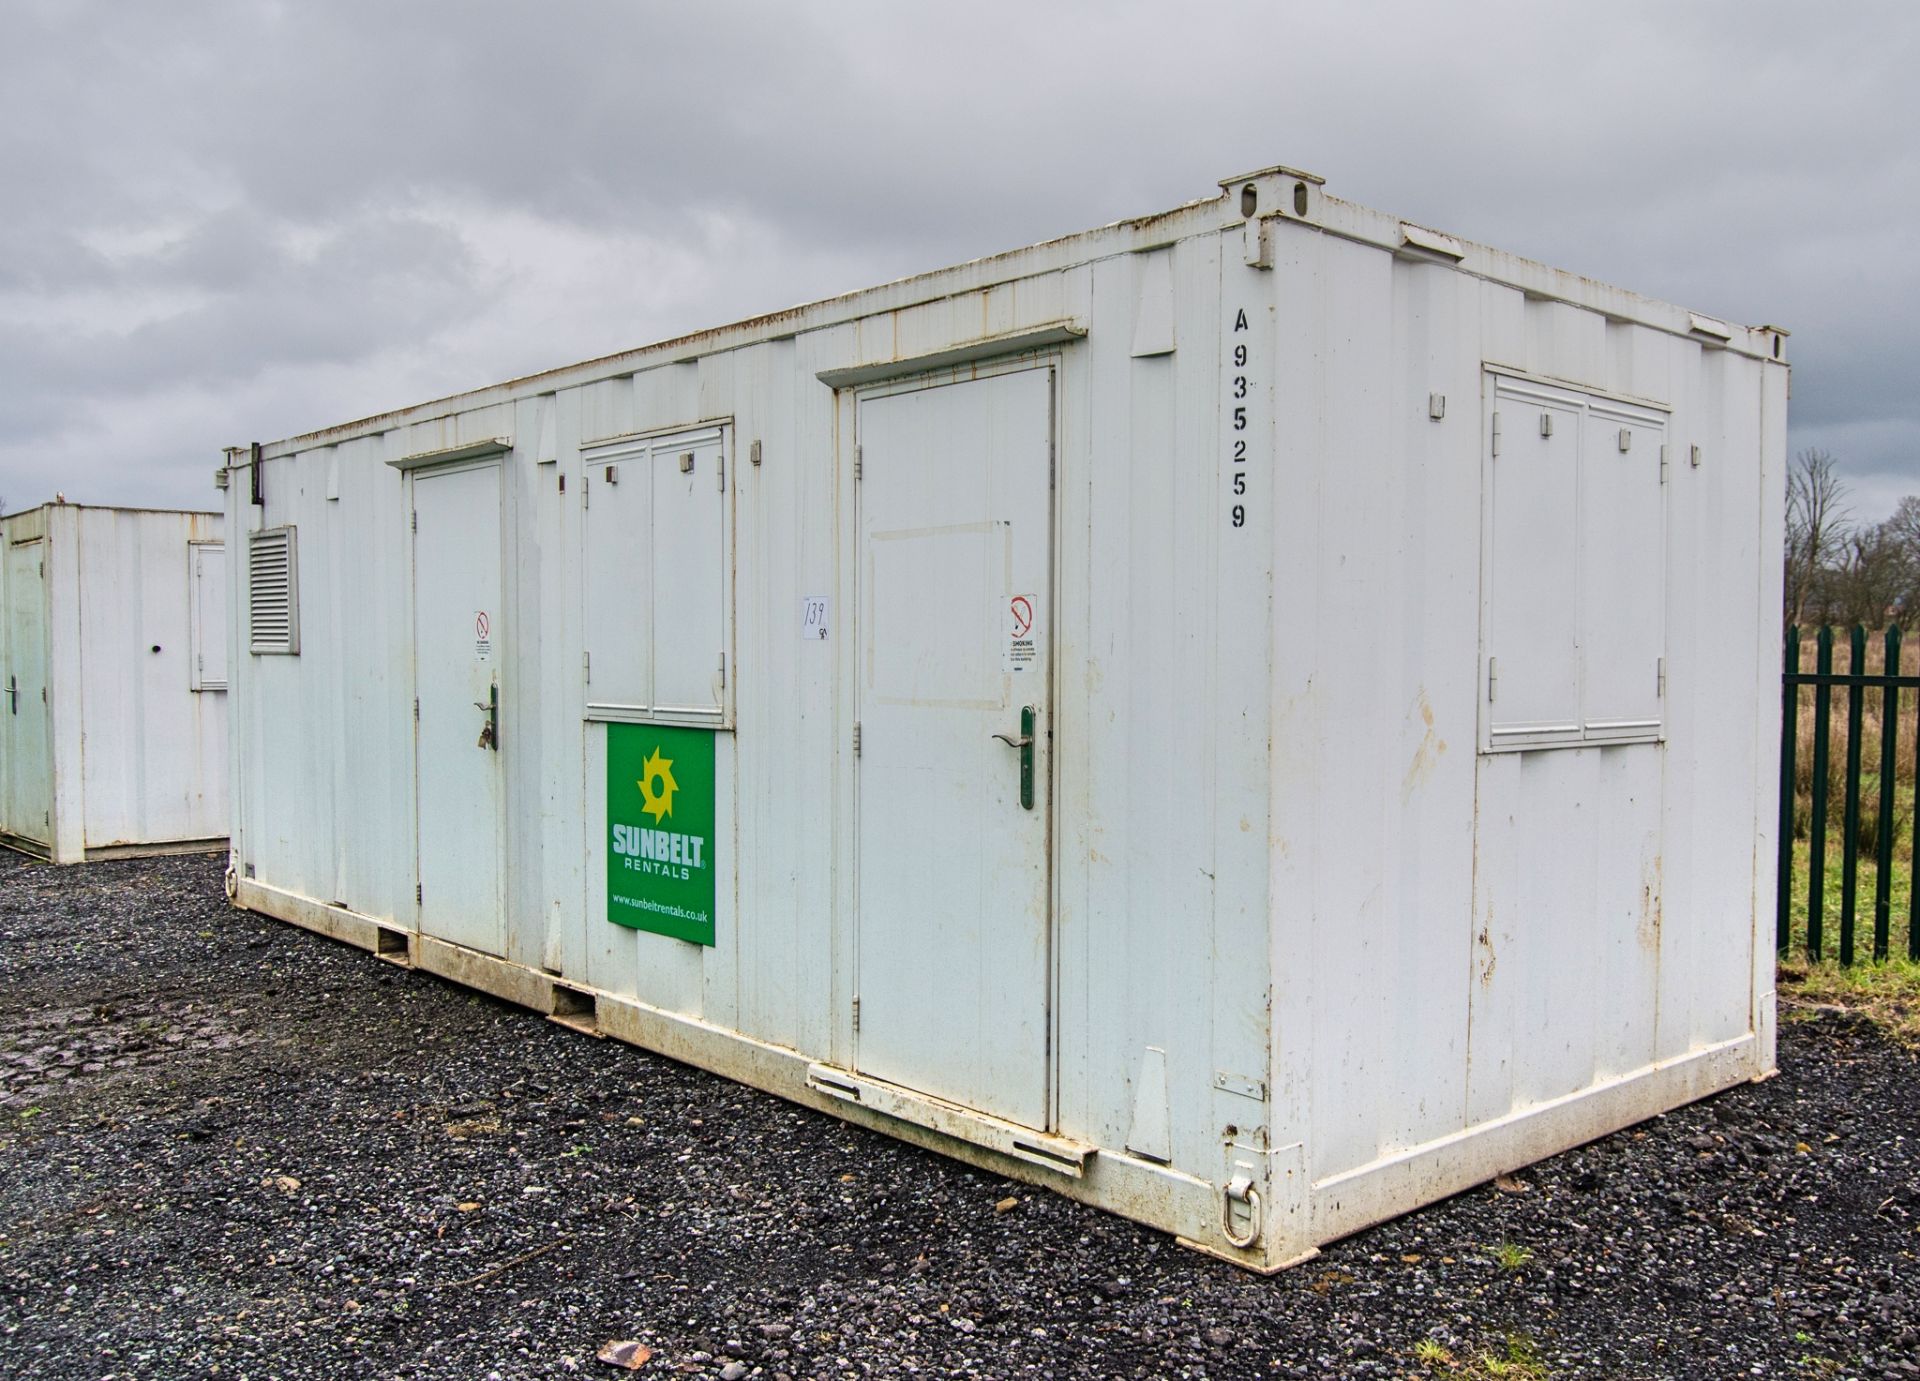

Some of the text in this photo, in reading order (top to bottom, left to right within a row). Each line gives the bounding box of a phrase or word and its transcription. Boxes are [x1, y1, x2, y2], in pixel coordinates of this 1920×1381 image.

[1232, 308, 1248, 528] A935259
[804, 602, 825, 625] 139
[613, 823, 704, 868] SUNBELT
[624, 859, 690, 880] RENTALS
[612, 893, 708, 922] www.sunbeltrentals.co.uk
